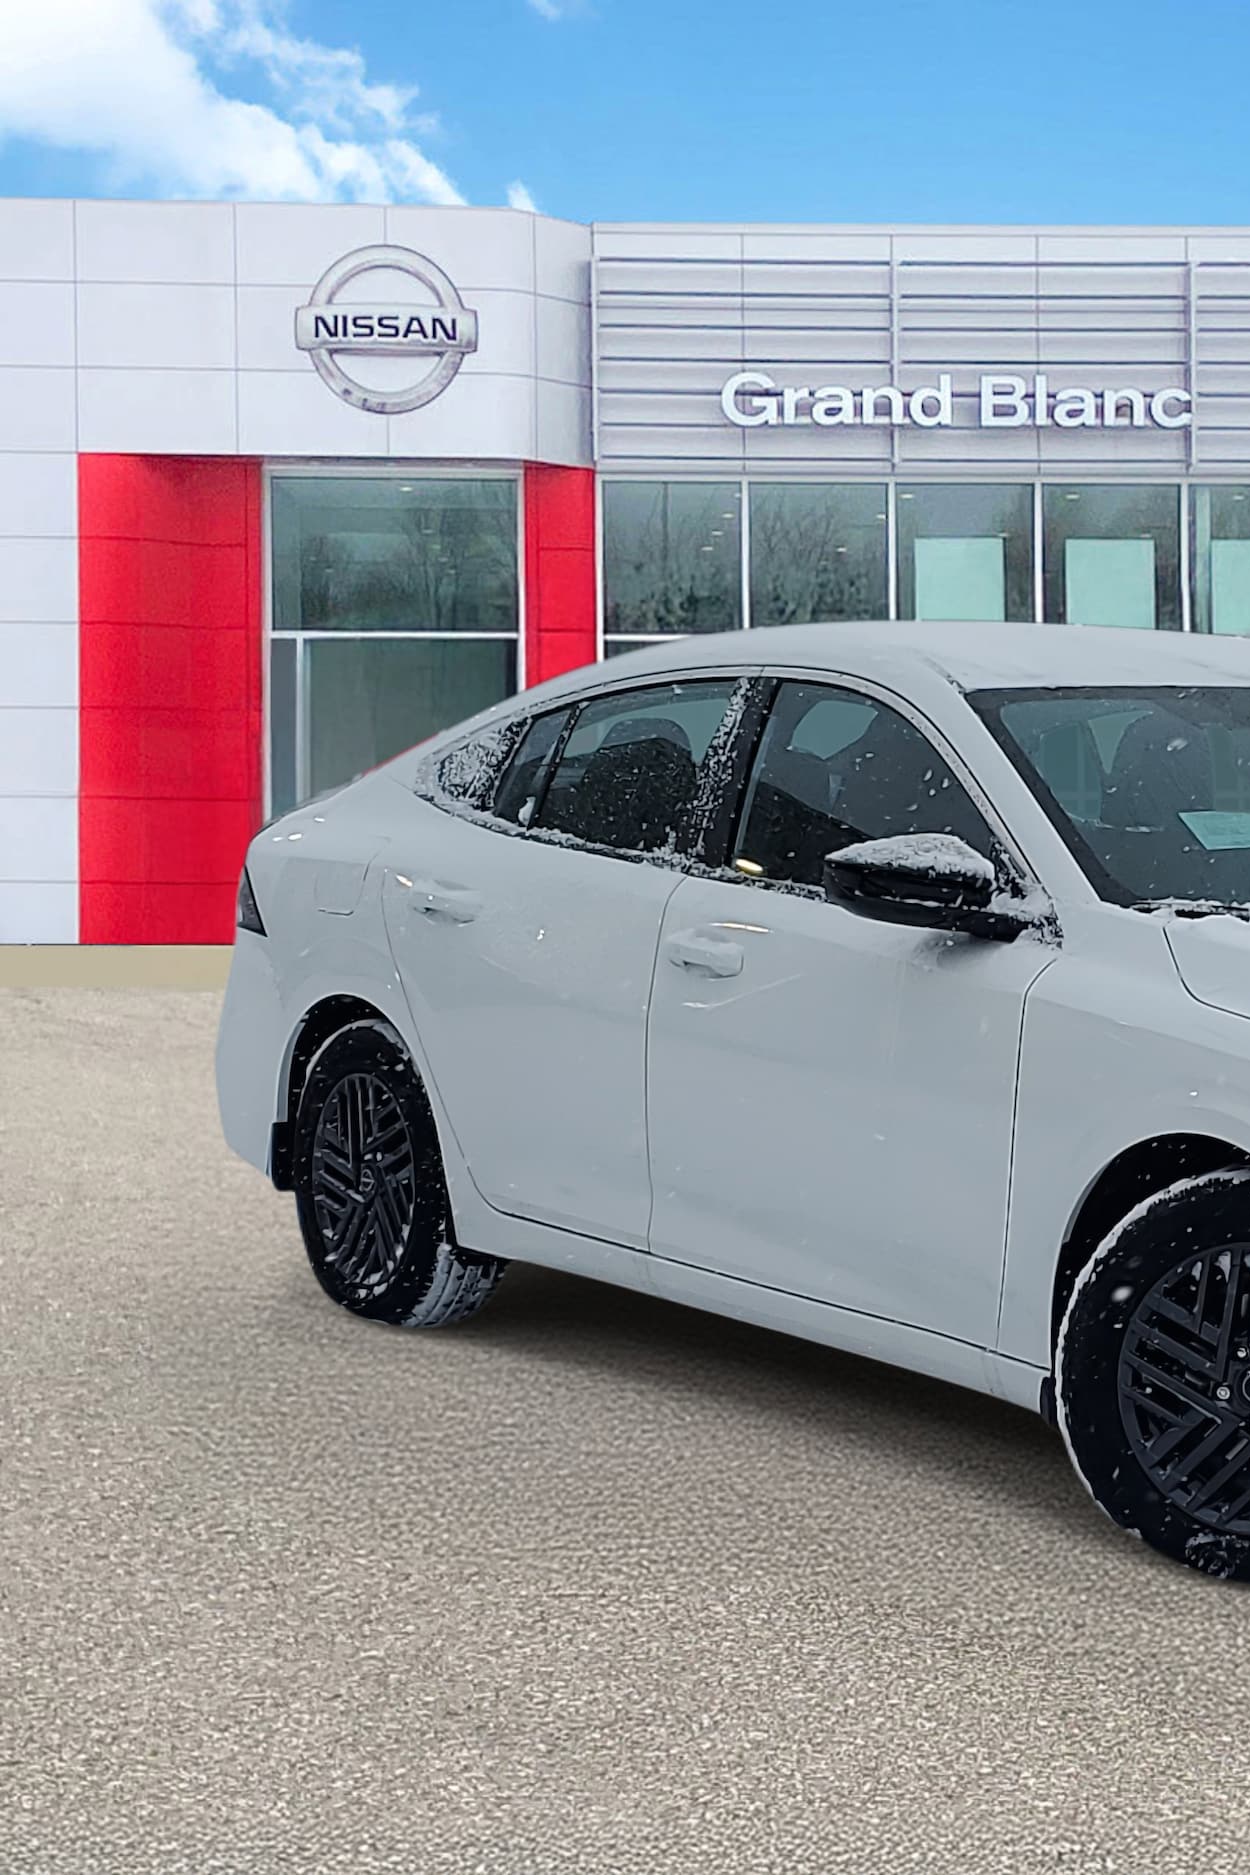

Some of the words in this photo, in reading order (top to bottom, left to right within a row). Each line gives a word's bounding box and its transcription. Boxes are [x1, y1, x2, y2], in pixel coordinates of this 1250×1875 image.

[314, 315, 457, 341] NISSAN
[721, 371, 952, 428] Grand
[979, 374, 1193, 428] Blanc
